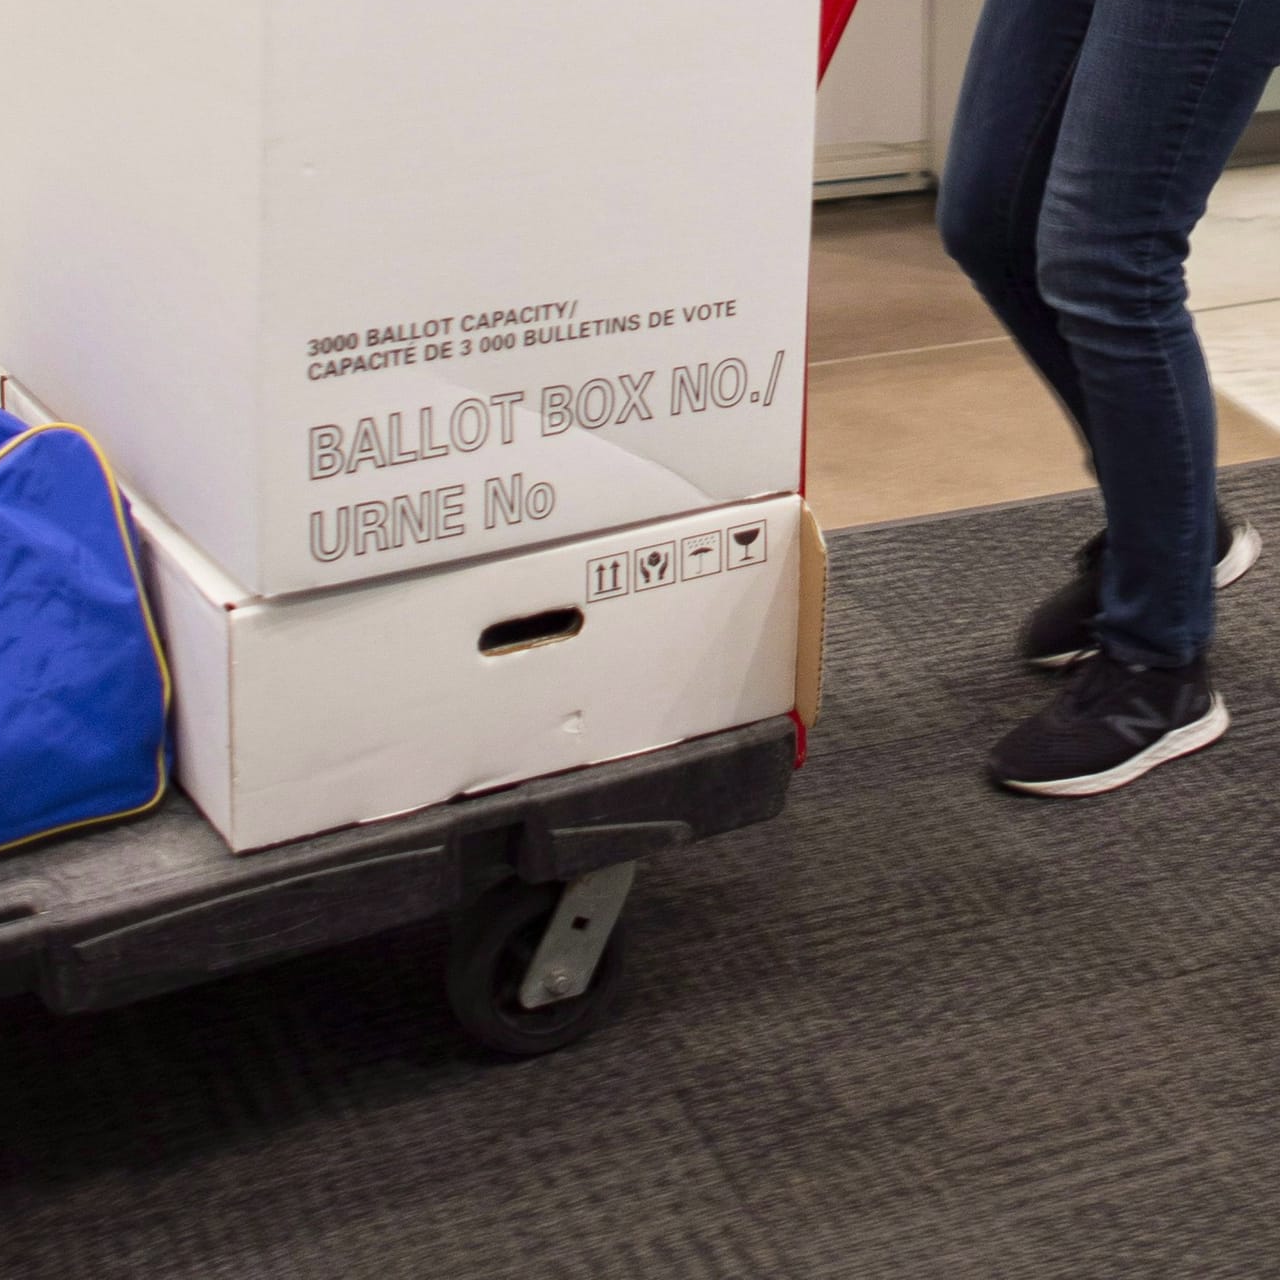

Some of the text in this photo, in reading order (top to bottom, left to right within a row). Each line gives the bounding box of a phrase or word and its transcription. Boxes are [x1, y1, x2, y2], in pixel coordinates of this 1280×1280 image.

[307, 299, 579, 357] 3000 BALLOT CAPACITY/
[307, 298, 738, 381] CAPACITÉ DE 3 000 BULLETINS DE VOTE
[309, 350, 785, 480] BALLOT BOX NO./
[309, 471, 556, 563] URNE No
